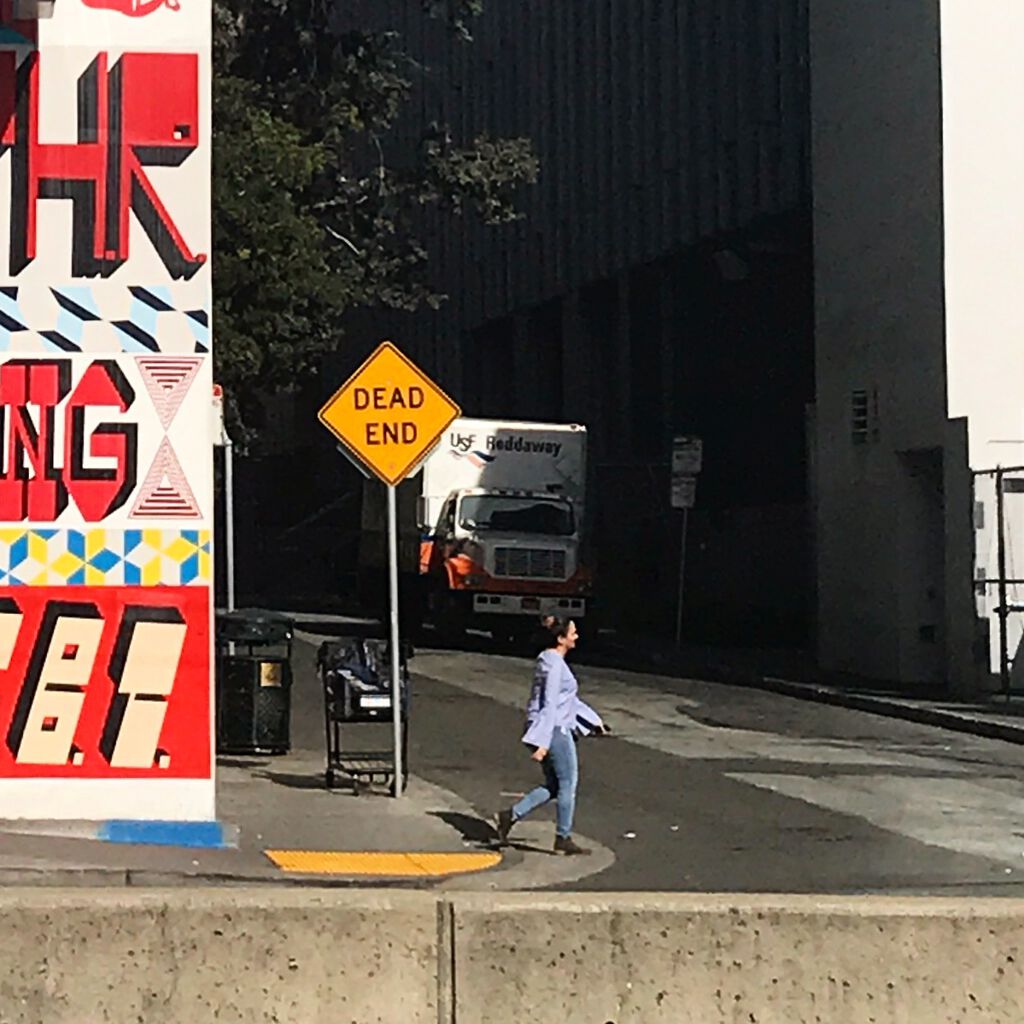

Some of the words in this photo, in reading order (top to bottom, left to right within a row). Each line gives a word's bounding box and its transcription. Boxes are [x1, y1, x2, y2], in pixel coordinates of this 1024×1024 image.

[353, 386, 425, 410] DEAD
[365, 422, 418, 446] END
[486, 436, 562, 457] Reddaway
